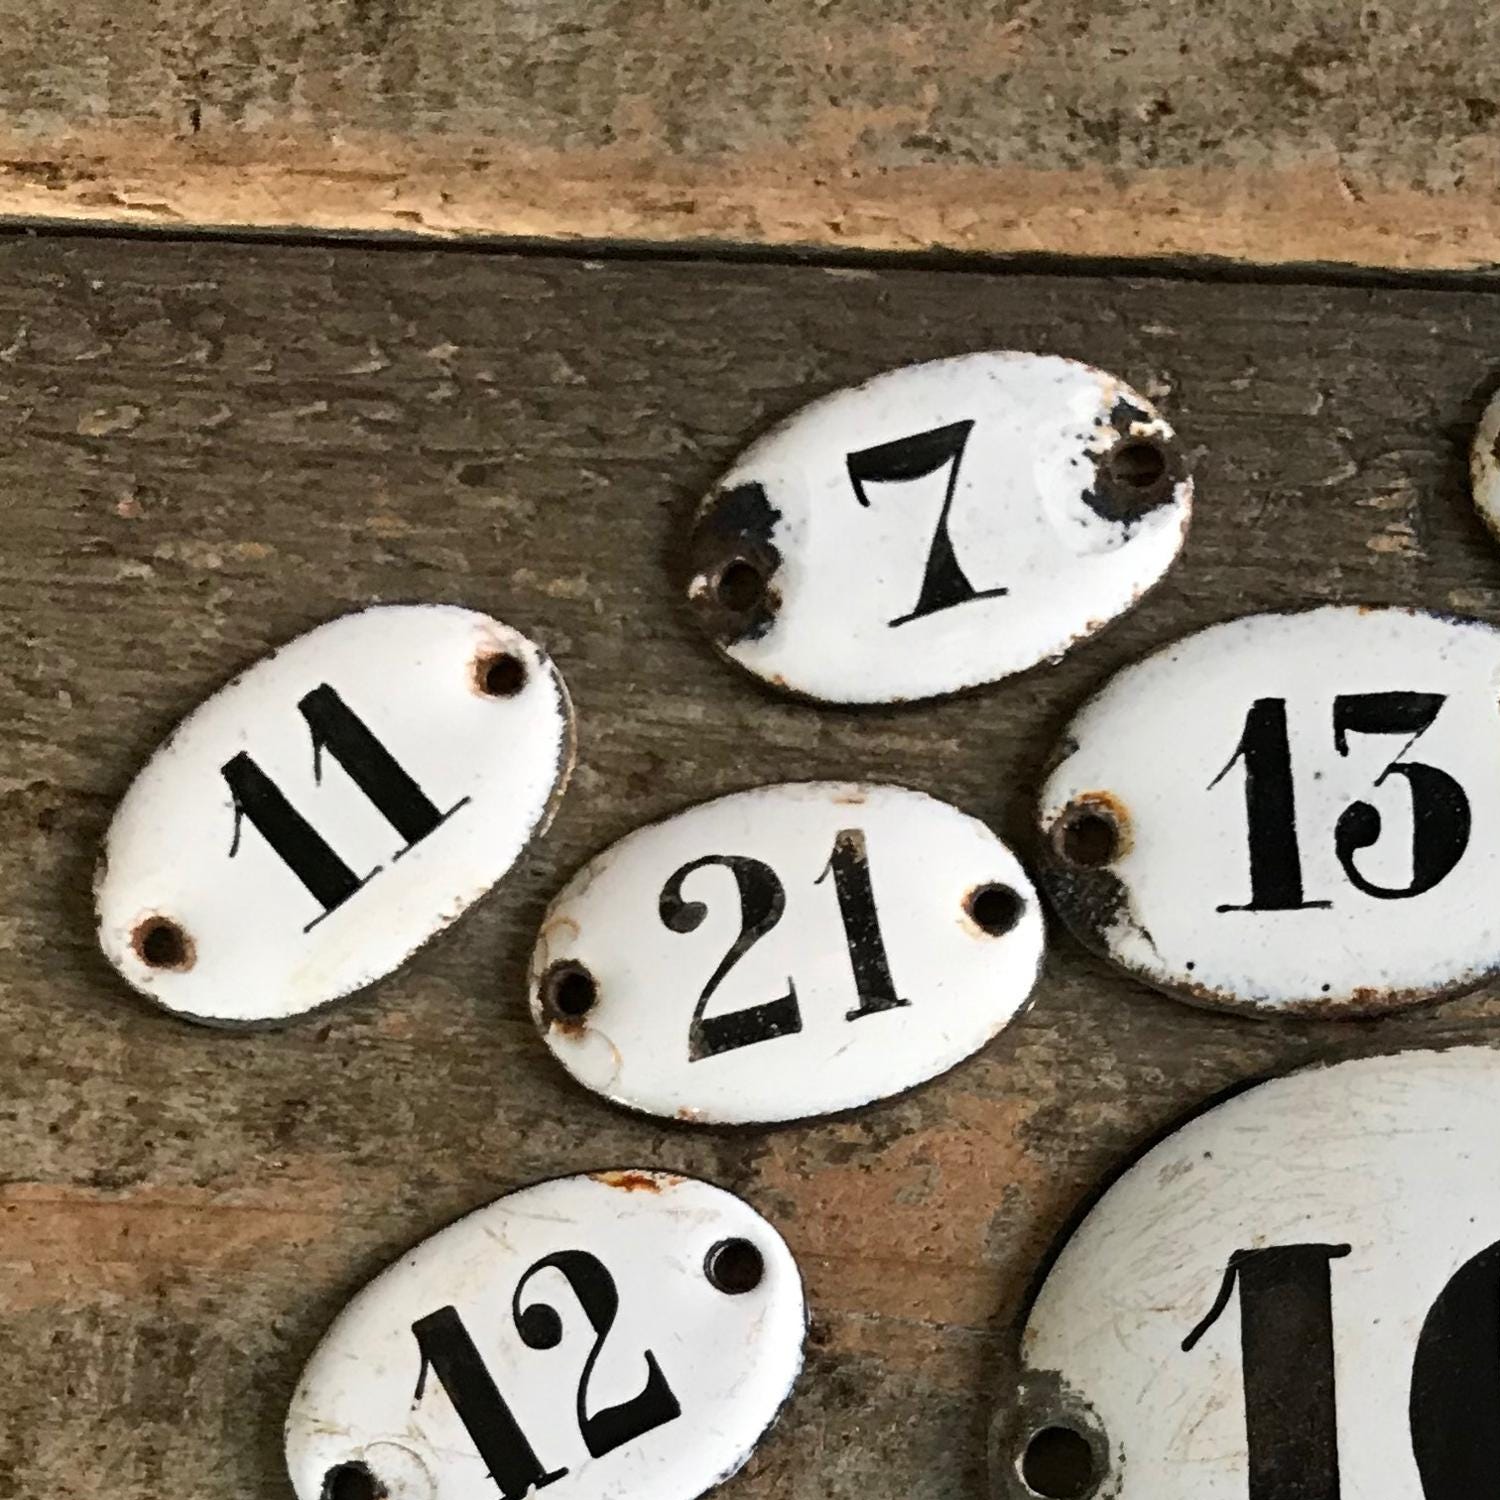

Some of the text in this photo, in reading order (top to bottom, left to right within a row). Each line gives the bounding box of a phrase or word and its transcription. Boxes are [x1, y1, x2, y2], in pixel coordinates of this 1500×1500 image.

[844, 418, 1009, 629] 7
[221, 681, 471, 934] 11
[1209, 689, 1473, 915] 13
[657, 828, 912, 1064] 21
